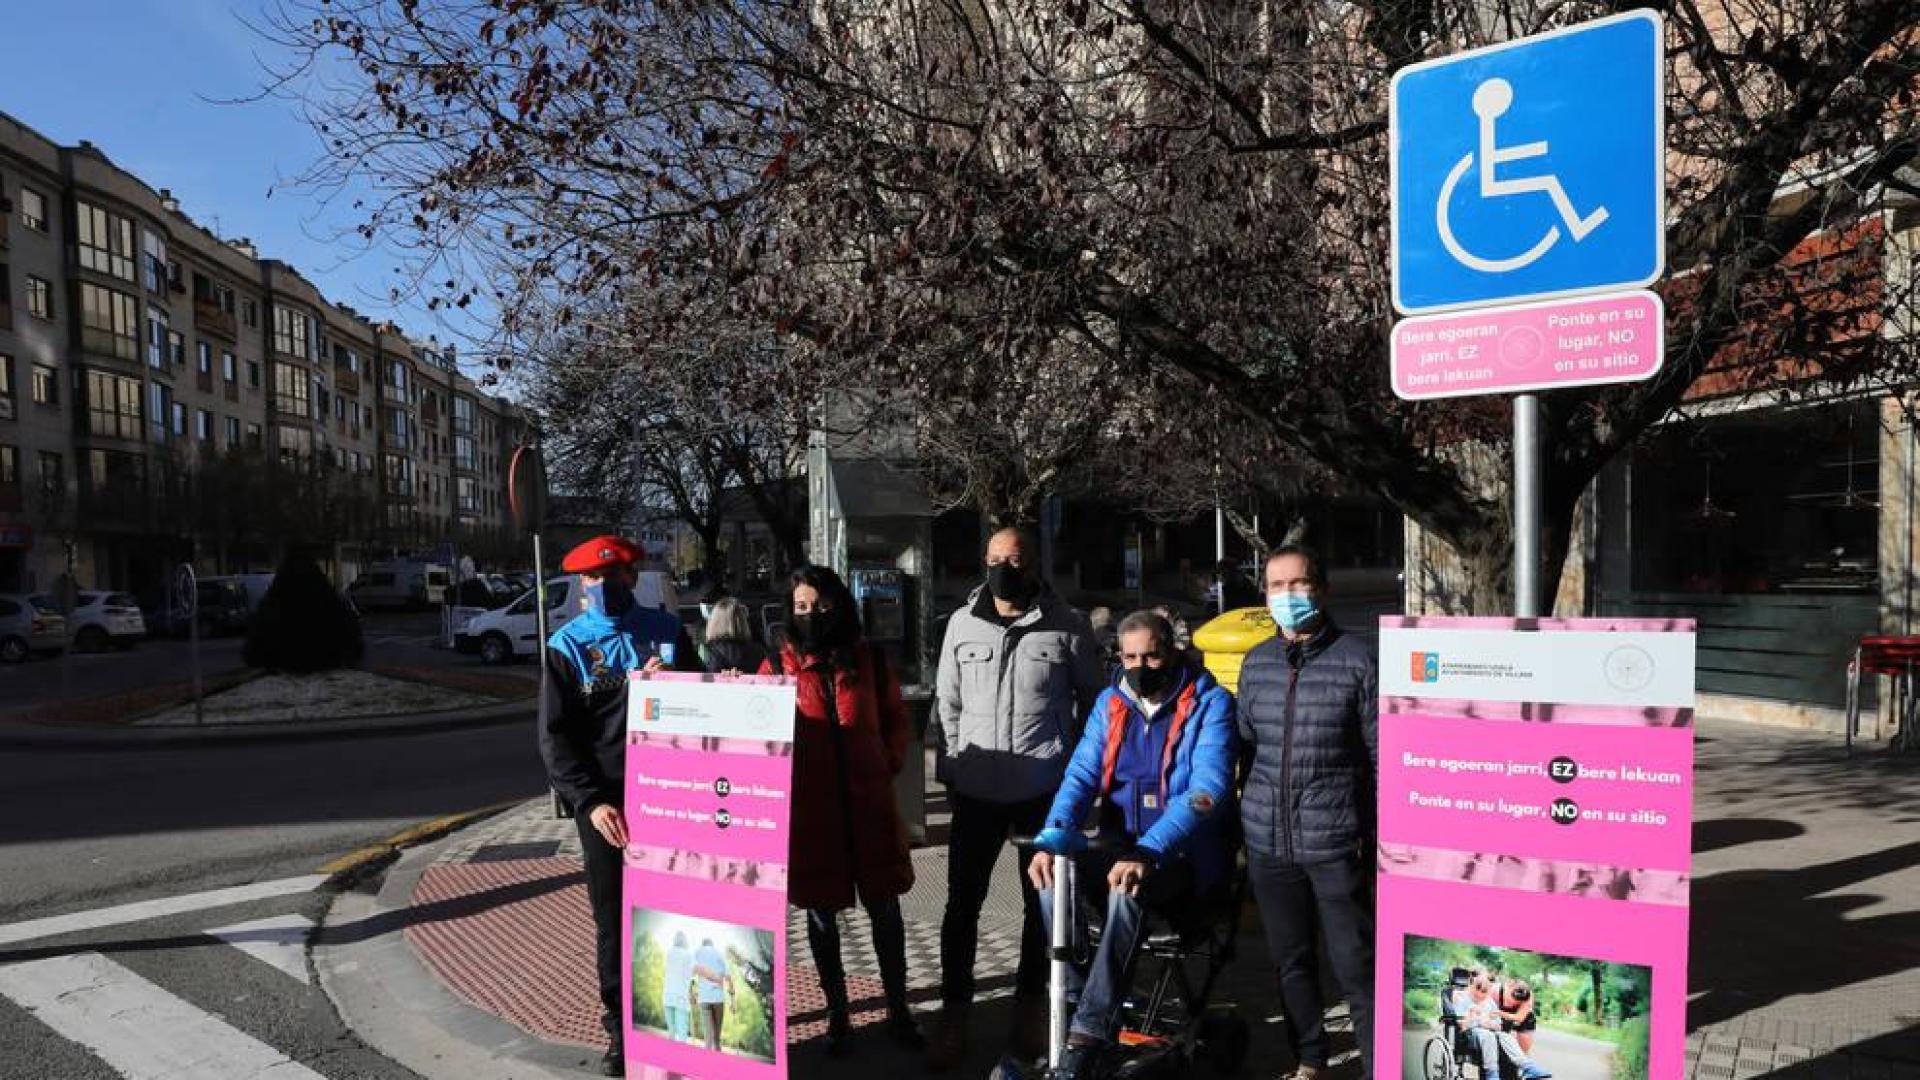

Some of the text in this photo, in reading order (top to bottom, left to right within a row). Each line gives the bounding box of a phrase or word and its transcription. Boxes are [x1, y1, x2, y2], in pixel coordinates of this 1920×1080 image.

[1548, 308, 1645, 328] Ponte en su
[1401, 325, 1498, 344] Bere egoeran
[1558, 329, 1635, 351] lugar, NO
[1554, 351, 1640, 371] en su sitio
[1407, 368, 1493, 386] bere lekuan
[1403, 752, 1681, 784] Bere egoeran jarri, EZ bere lekuan
[1409, 790, 1667, 825] Ponte en su lugar, NO en su sitio
